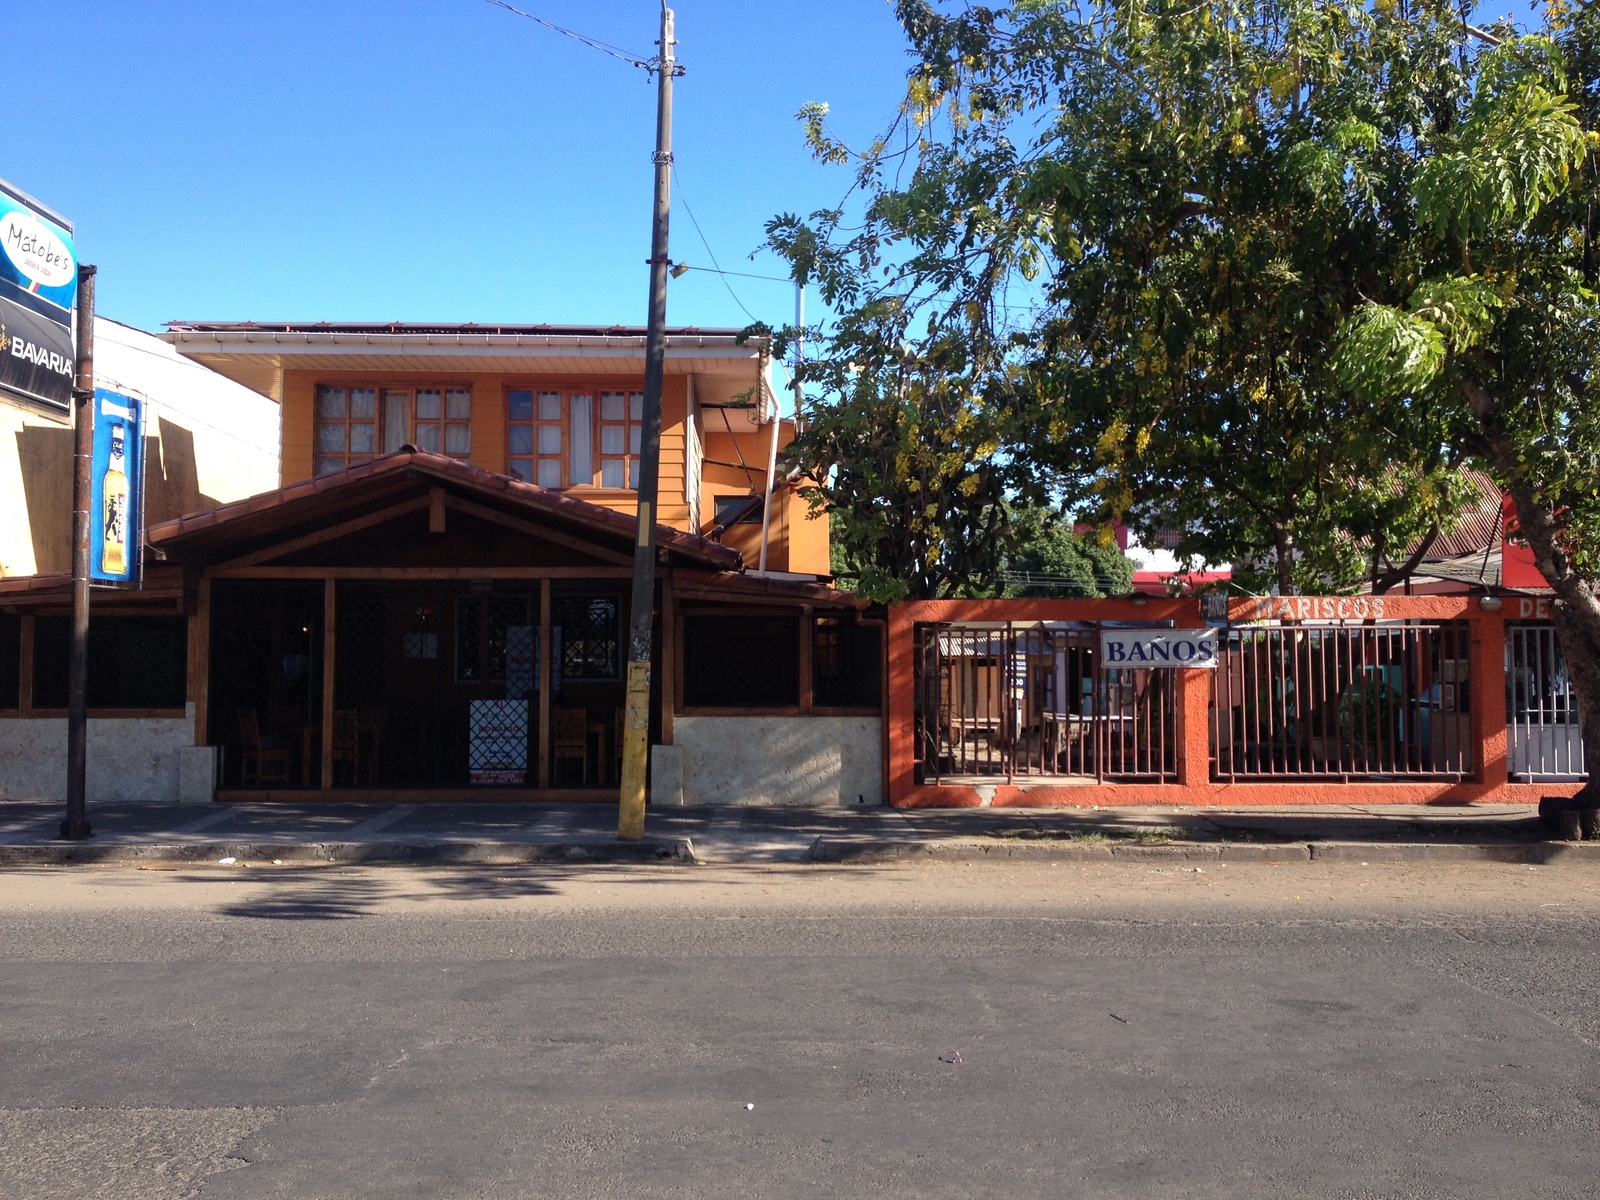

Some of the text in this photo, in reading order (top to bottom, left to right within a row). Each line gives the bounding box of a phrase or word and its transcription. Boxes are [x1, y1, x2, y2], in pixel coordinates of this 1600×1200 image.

[8, 223, 69, 271] Matobe's
[11, 336, 73, 379] BAVARIA
[1256, 598, 1384, 619] MARISCOS
[1520, 598, 1549, 619] DE
[1107, 635, 1213, 661] BAÑOS
